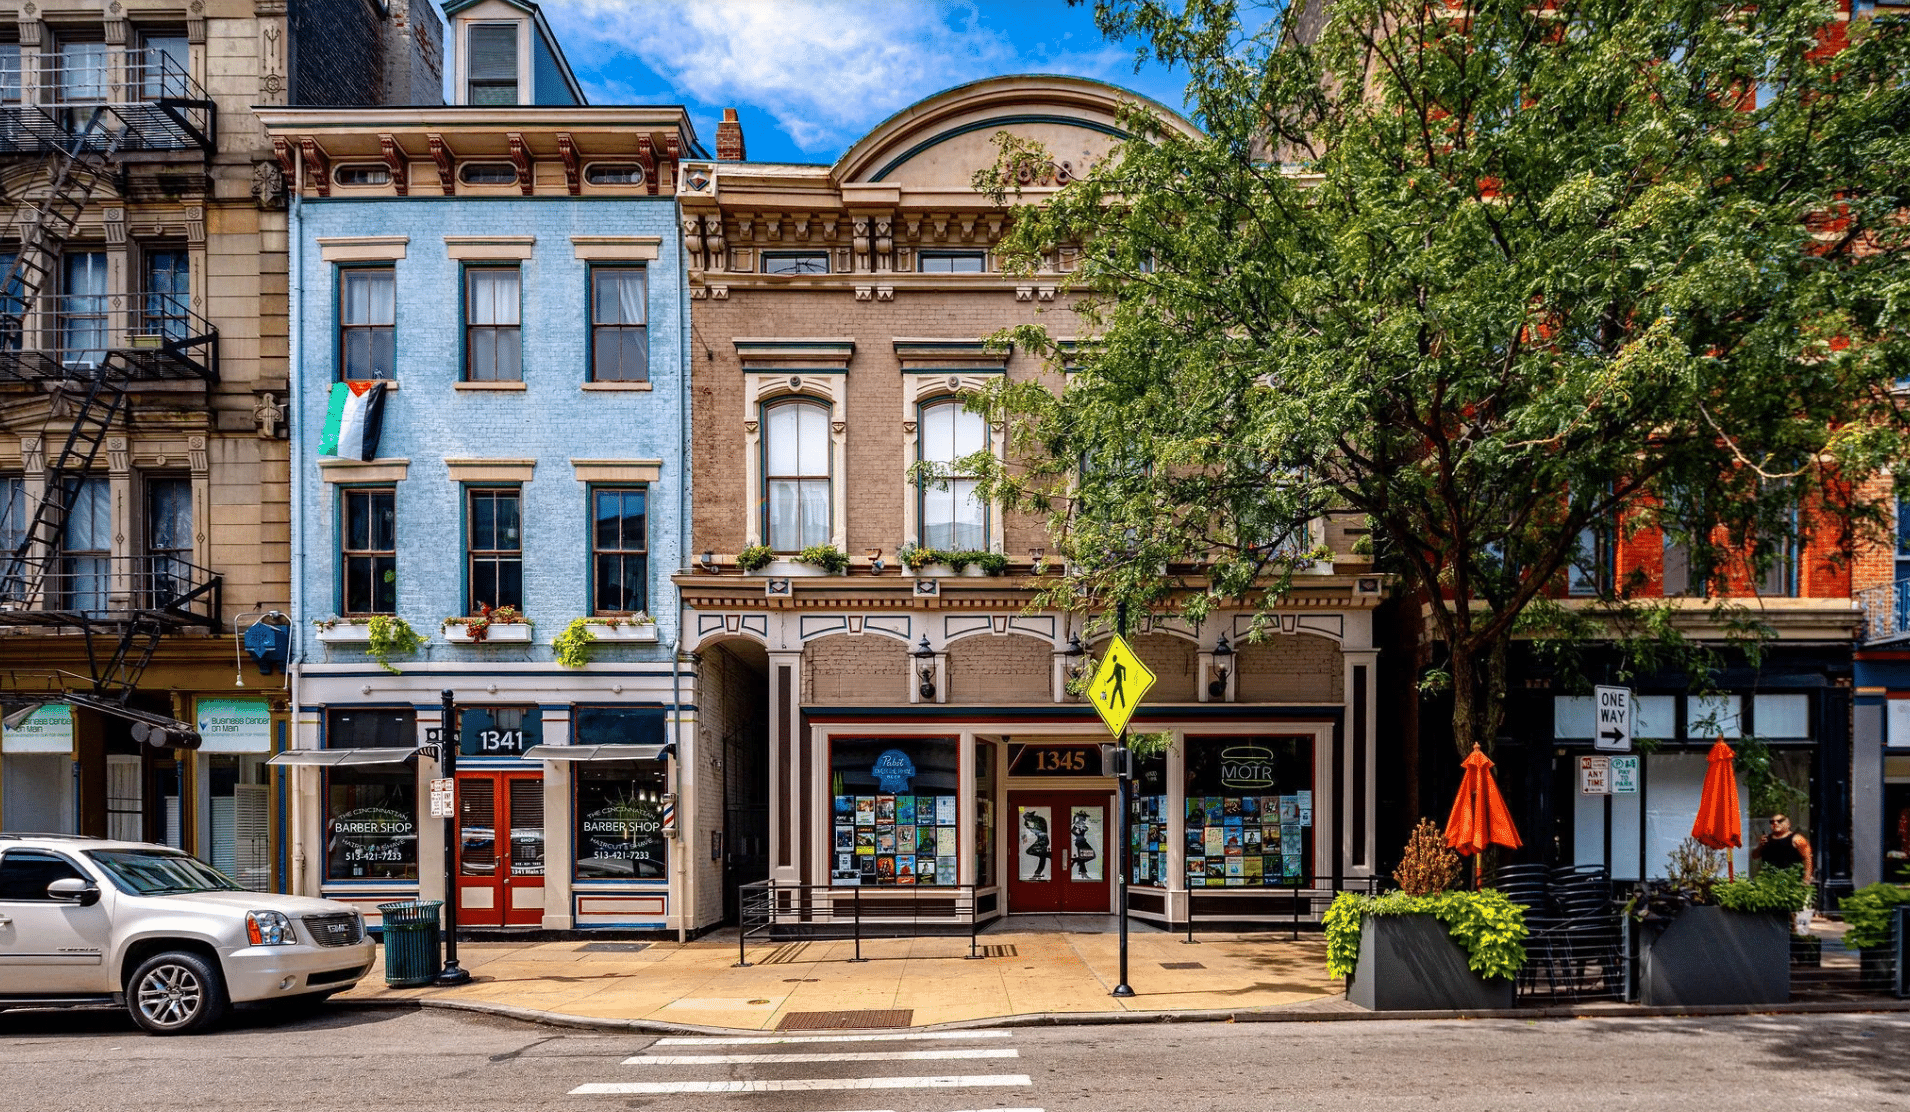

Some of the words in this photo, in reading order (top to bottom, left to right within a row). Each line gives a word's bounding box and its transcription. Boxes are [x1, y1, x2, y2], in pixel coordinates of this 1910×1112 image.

[1602, 692, 1625, 707] ONE
[212, 717, 244, 725] Business
[1601, 709, 1625, 723] WAY
[480, 731, 523, 750] 1341
[883, 755, 904, 766] Pabst
[1036, 751, 1085, 770] 1345
[1222, 765, 1272, 779] MOTR
[338, 811, 352, 820] THE
[353, 807, 408, 820] CINCINNATIAN
[587, 810, 601, 819] THE
[335, 822, 378, 833] BARBER
[380, 822, 412, 833] SHOP
[584, 821, 626, 832] BARBER
[629, 821, 660, 832] SHOP
[345, 852, 402, 860] 513-421-7233
[593, 851, 650, 860] 513-421-7233
[327, 923, 349, 933] GMC
